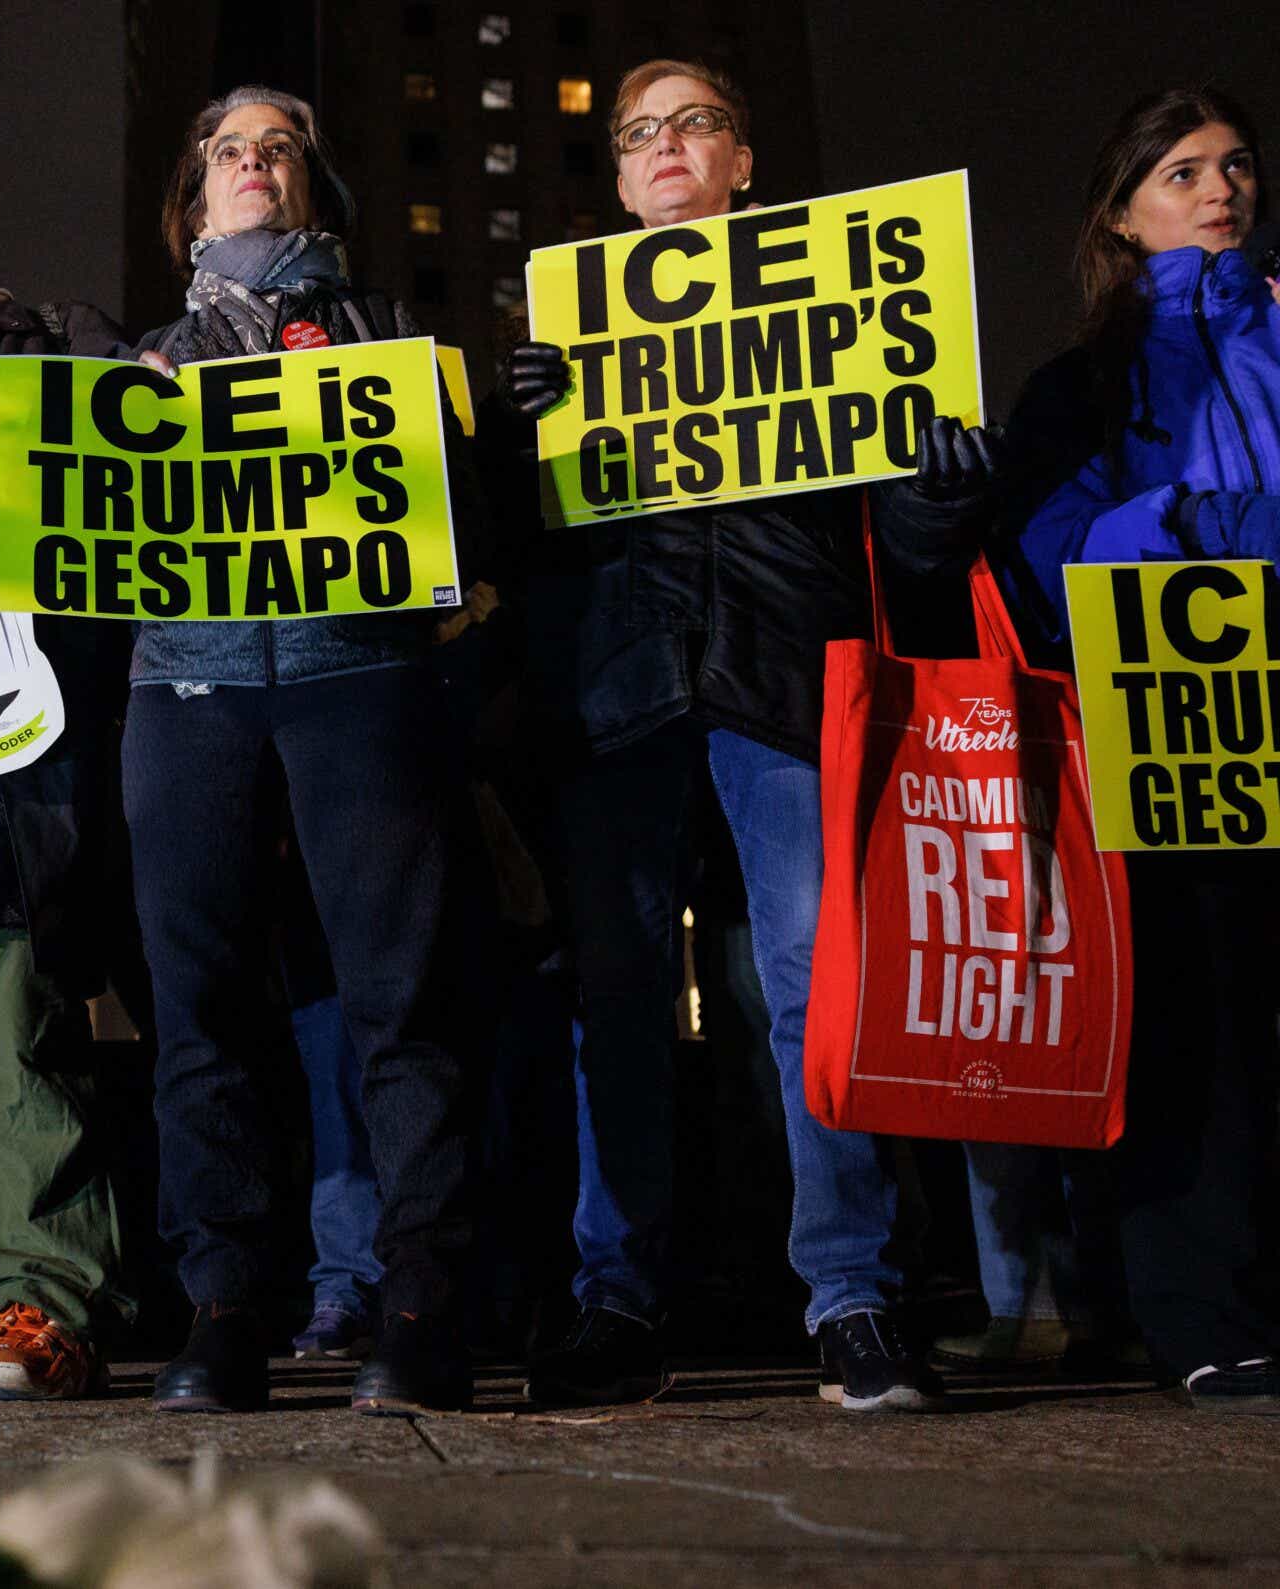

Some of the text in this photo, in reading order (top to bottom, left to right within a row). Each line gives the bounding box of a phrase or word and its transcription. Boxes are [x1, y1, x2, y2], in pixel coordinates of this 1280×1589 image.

[575, 205, 926, 336] ICE is
[568, 290, 936, 421] TRUMP'S
[40, 358, 396, 454] ICE is
[579, 384, 936, 507] GESTAPO
[28, 444, 410, 535] TRUMP'S
[33, 530, 412, 618] GESTAPO
[1111, 565, 1280, 664] IC
[959, 697, 1012, 725] 75 YEARS
[1112, 670, 1280, 755] TRU
[903, 823, 1071, 954] RED
[905, 949, 1074, 1046] LIGHT
[967, 1077, 995, 1090] 1949
